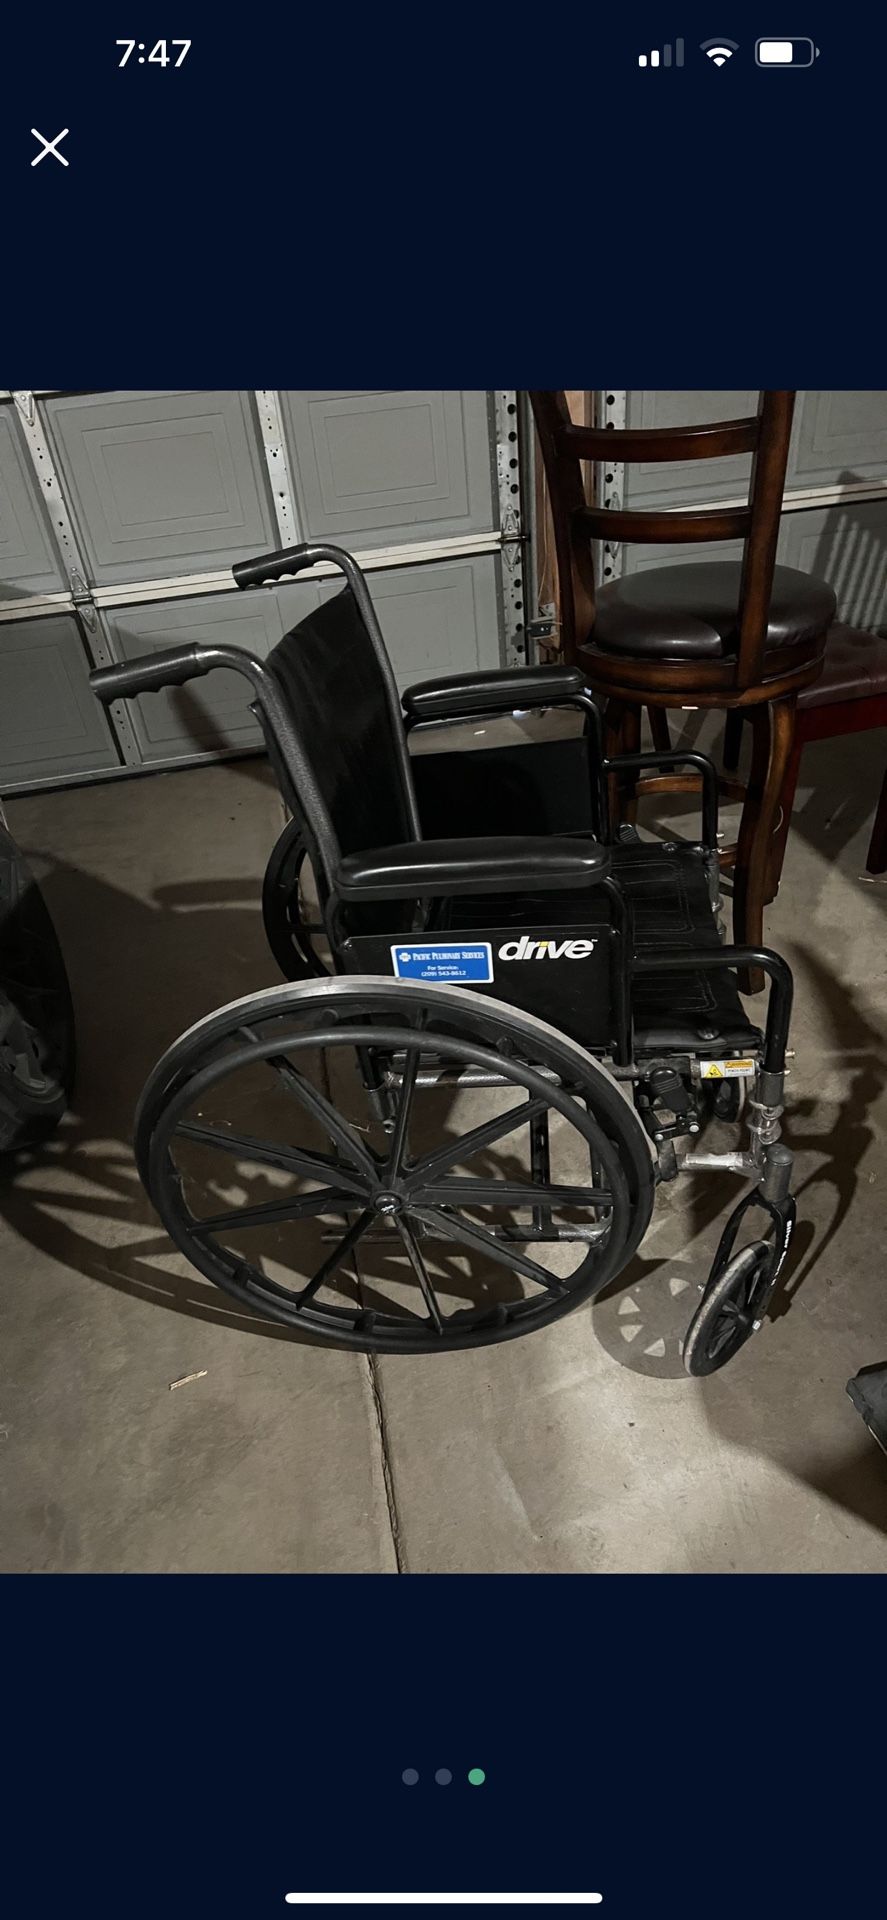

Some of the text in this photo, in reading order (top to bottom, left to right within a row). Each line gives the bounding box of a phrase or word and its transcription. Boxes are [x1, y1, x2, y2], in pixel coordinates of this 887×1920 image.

[412, 952, 432, 961] PACIFIC
[461, 951, 485, 960] SERVICES
[498, 935, 595, 961] drive
